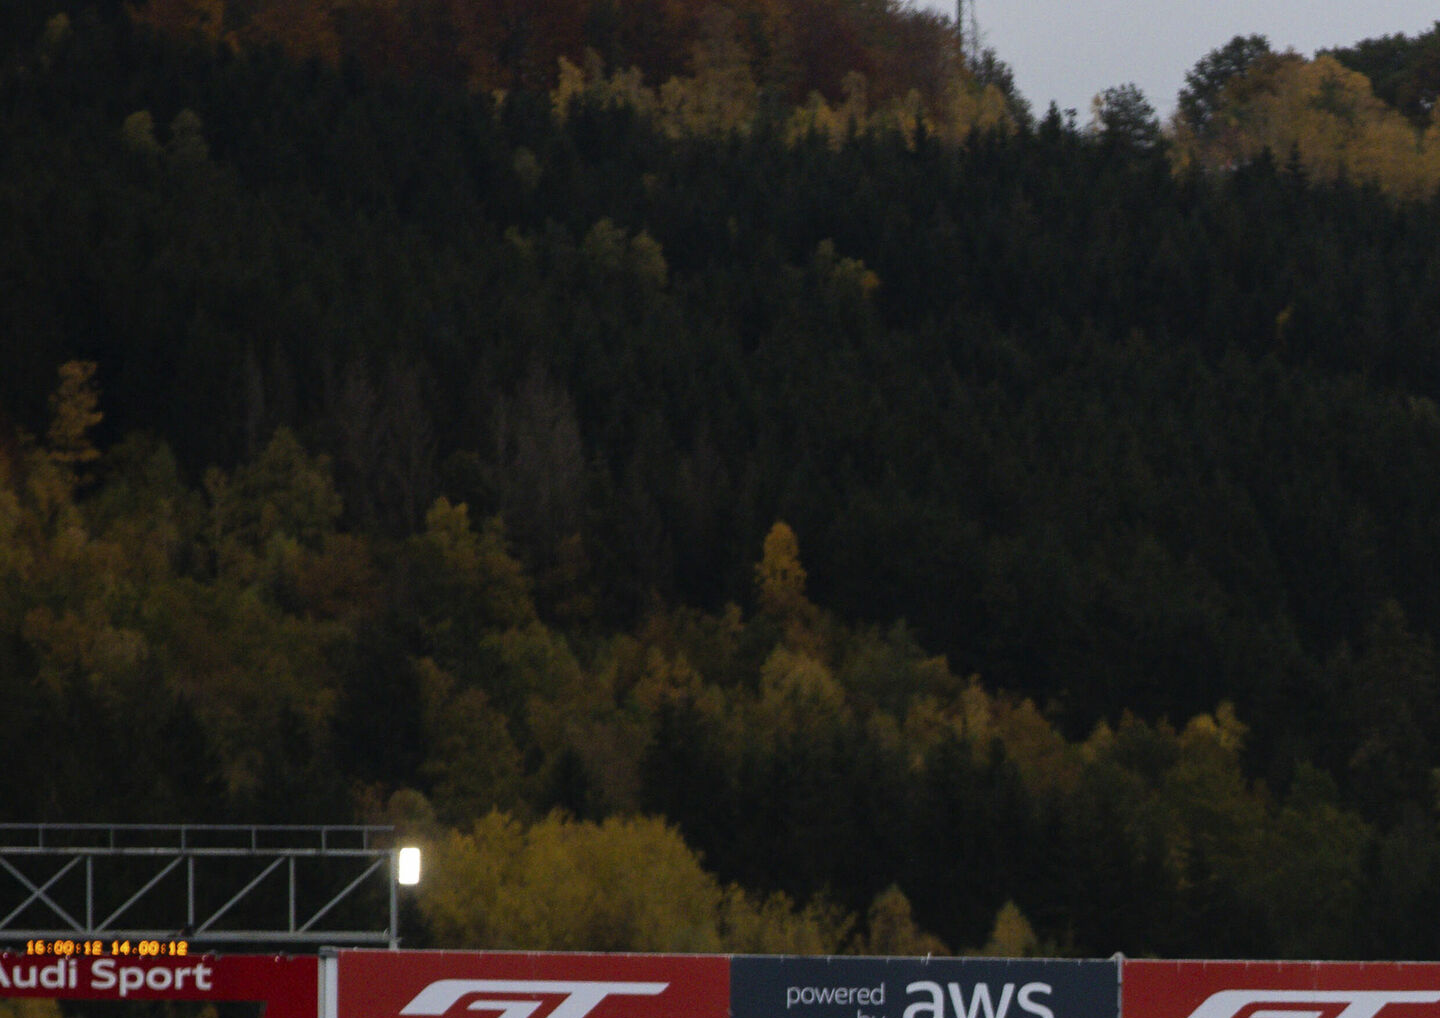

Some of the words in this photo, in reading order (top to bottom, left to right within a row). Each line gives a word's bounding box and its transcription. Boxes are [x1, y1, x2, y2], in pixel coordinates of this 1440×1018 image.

[26, 940, 103, 955] 16:00:12
[91, 958, 212, 997] Sport
[786, 982, 885, 1009] powered
